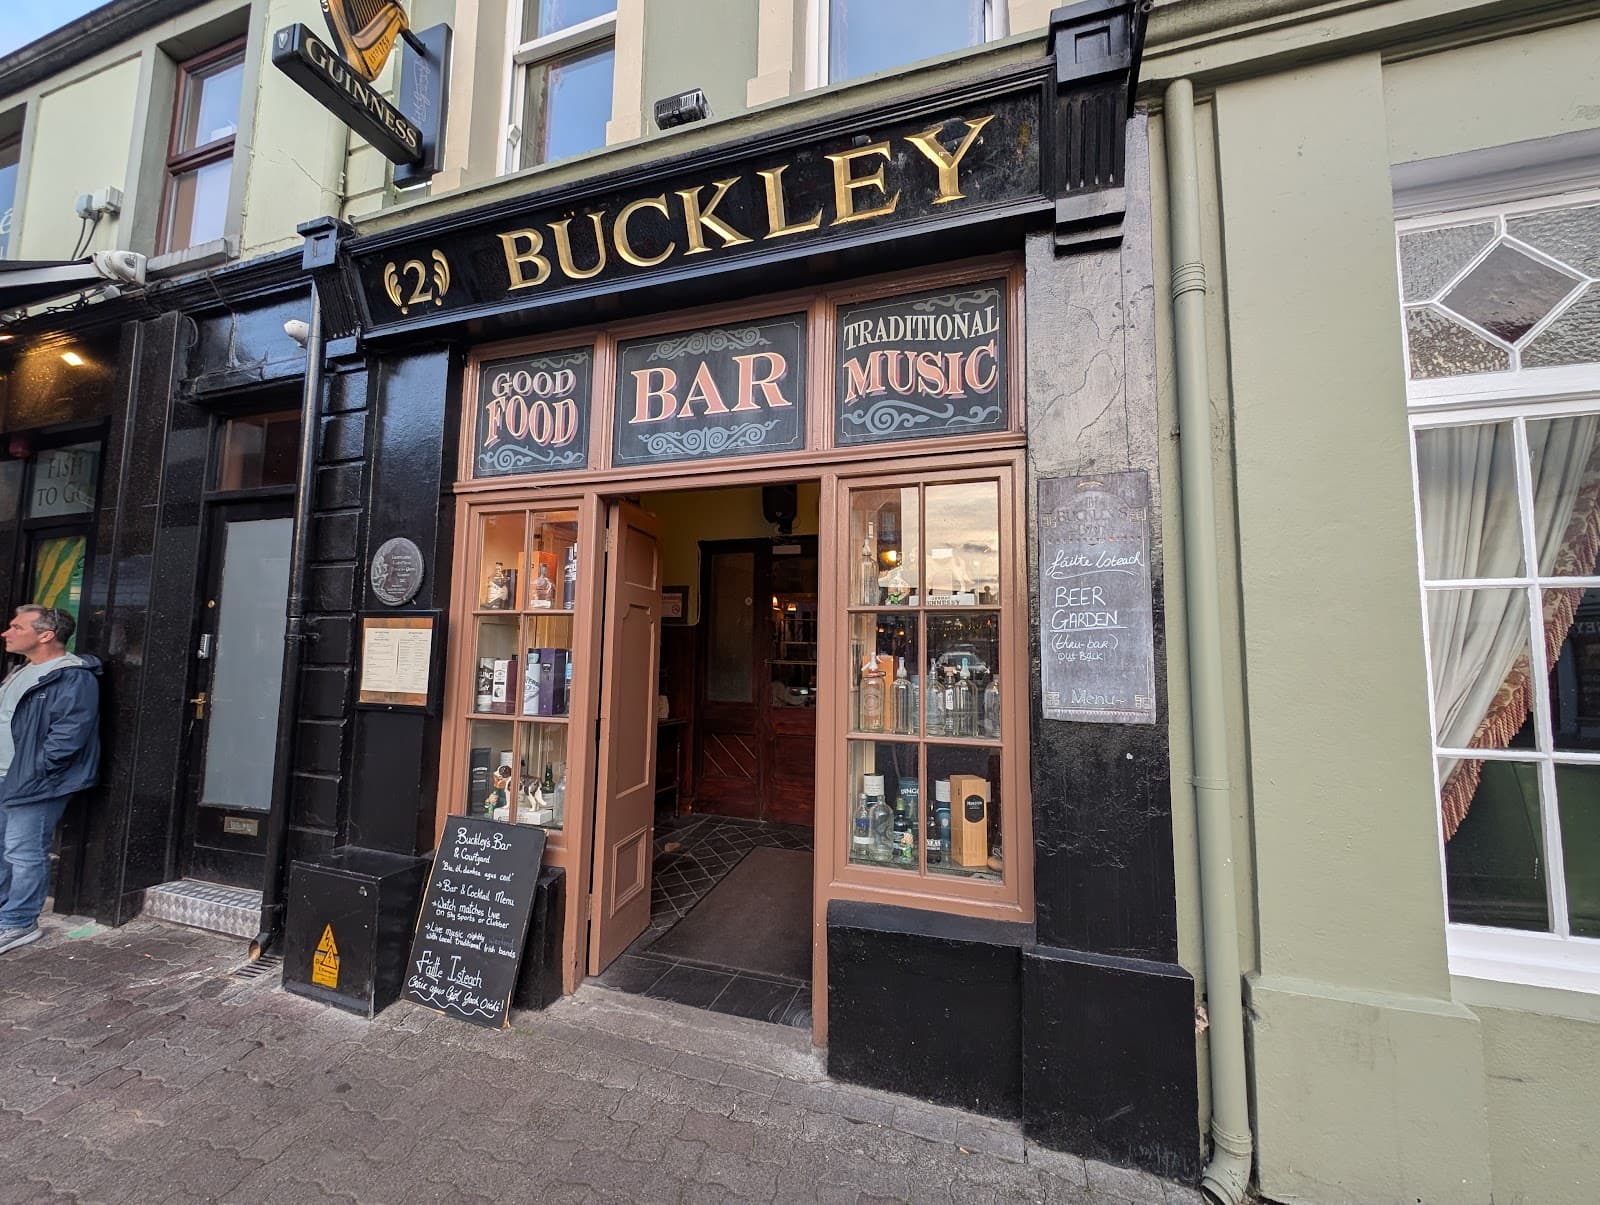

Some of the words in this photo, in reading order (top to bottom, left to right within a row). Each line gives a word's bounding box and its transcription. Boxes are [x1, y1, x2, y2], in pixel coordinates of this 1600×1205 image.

[306, 37, 417, 148] GUINNESS
[496, 114, 996, 292] BUCKLEY
[844, 305, 1000, 350] TRADITIONAL
[491, 368, 576, 398] GOOD
[843, 338, 999, 406] MUSIC
[628, 351, 793, 425] BAR
[484, 395, 579, 448] FOOD
[37, 487, 58, 506] TO
[1055, 585, 1106, 608] BEER
[1051, 609, 1118, 630] GARDEN
[455, 827, 491, 851] Buckley's
[490, 832, 512, 850] Bar
[453, 847, 460, 858] &
[460, 847, 491, 865] Courtyard
[437, 896, 457, 912] Watch
[458, 901, 485, 917] matches
[441, 879, 458, 893] Bar
[460, 883, 466, 895] &
[466, 884, 491, 901] Cocktail
[494, 890, 515, 907] Menu
[430, 921, 444, 934] Live
[445, 928, 464, 939] music
[466, 931, 486, 943] nightly
[498, 946, 516, 959] bands
[446, 955, 483, 989] Isteach
